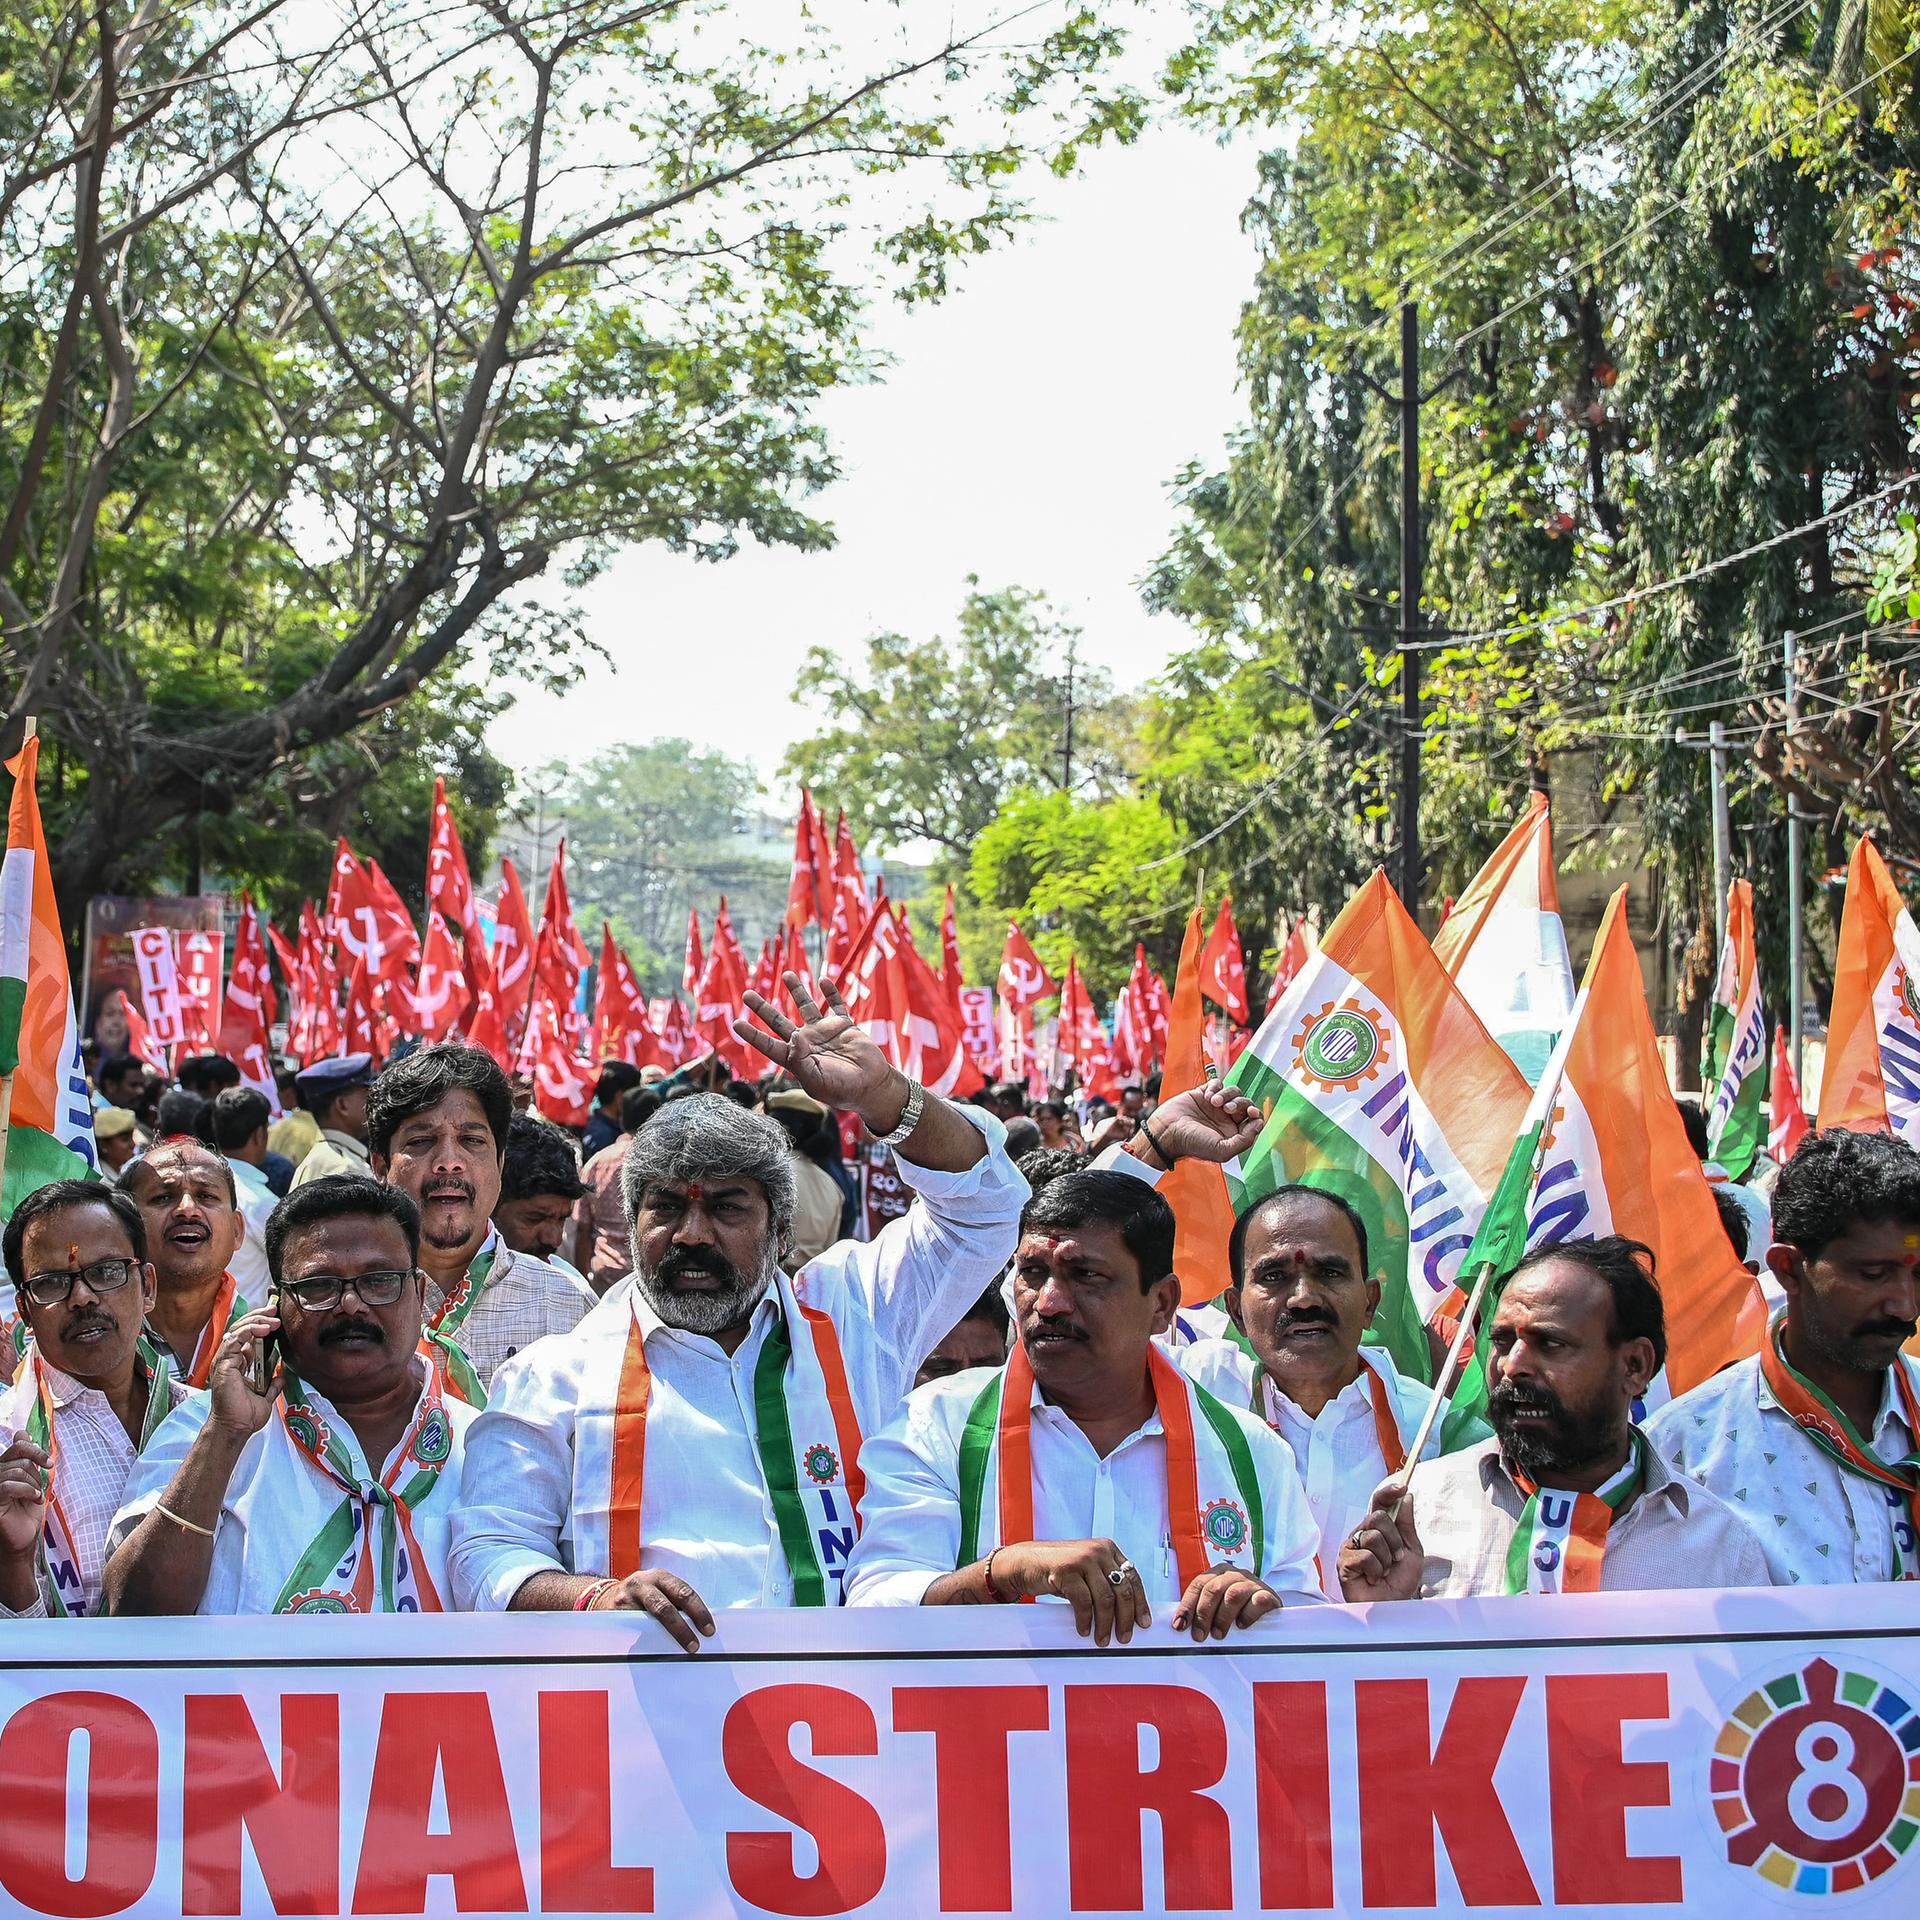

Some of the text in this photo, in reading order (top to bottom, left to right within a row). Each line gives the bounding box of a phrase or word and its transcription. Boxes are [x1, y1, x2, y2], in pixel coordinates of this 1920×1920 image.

[140, 932, 176, 1041] CITU
[722, 1672, 1684, 1917] STRIKE
[1787, 1720, 1868, 1841] 8
